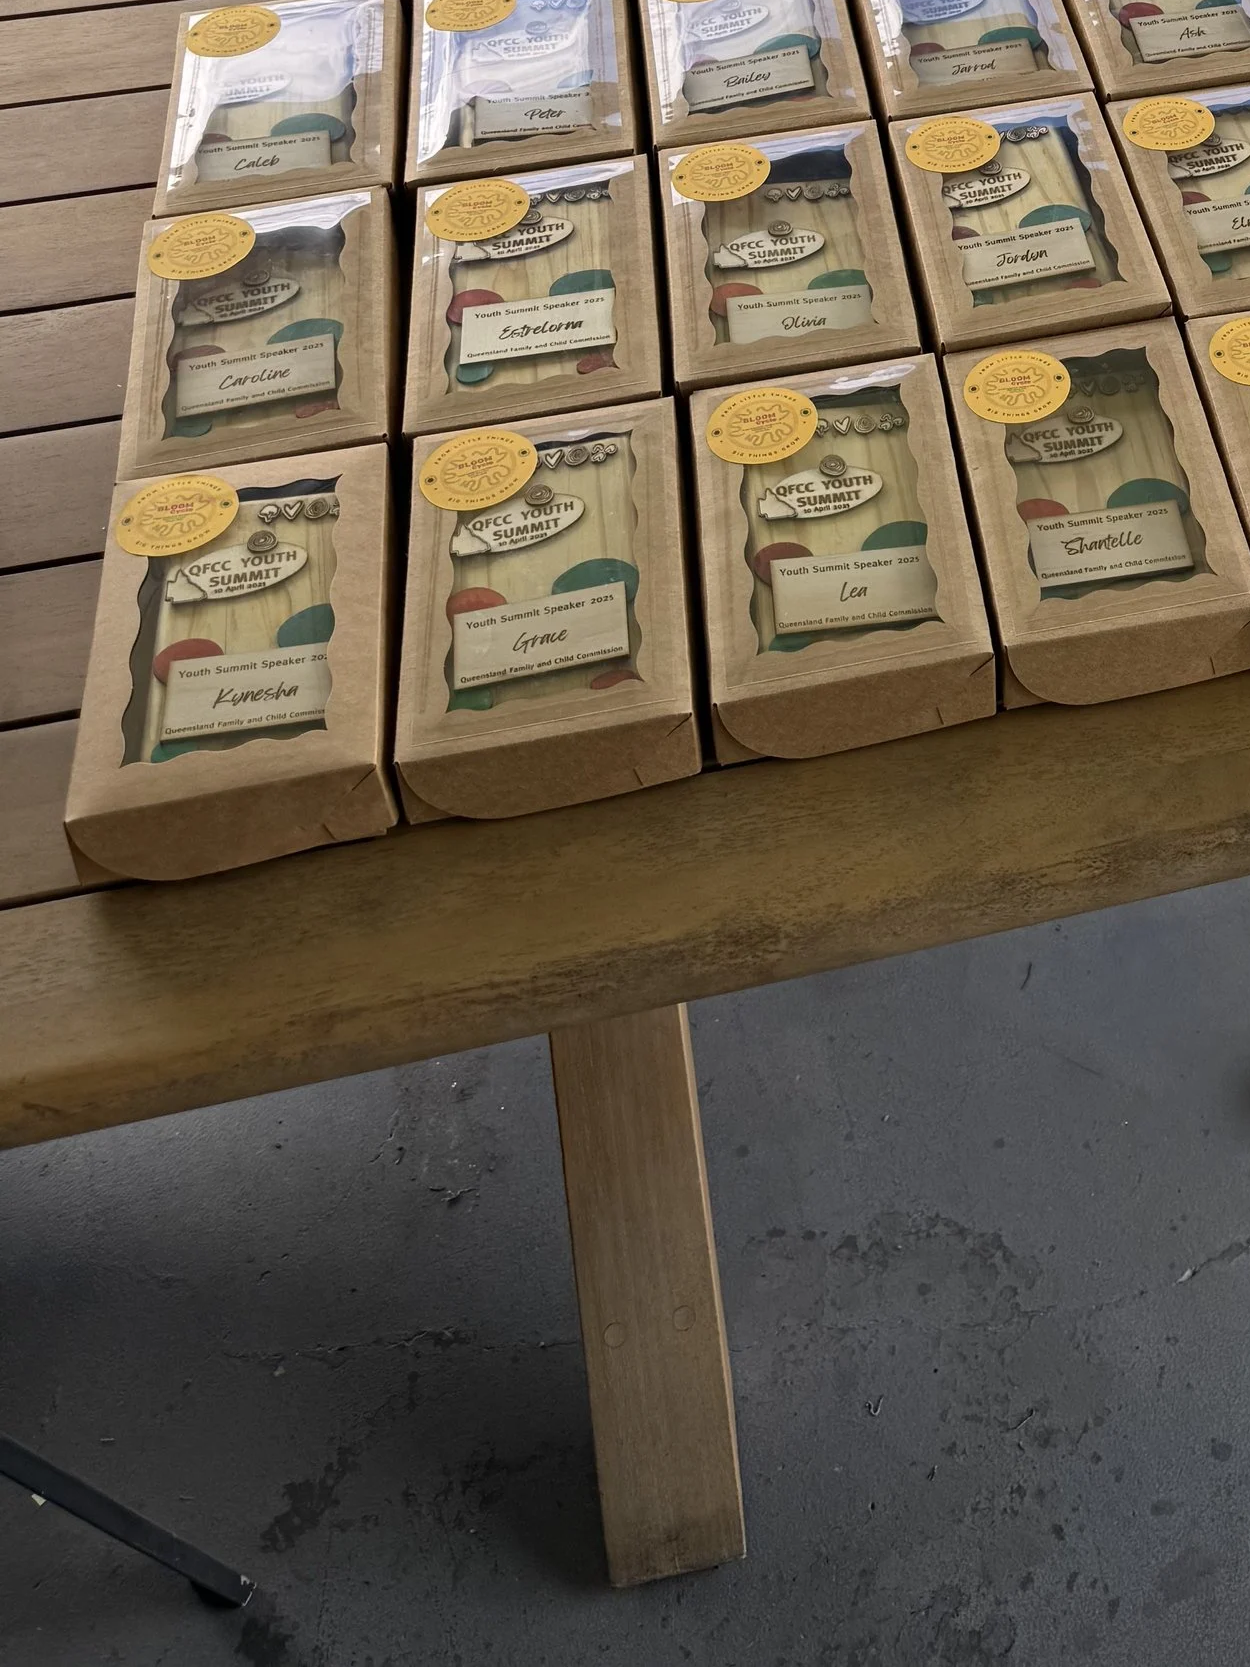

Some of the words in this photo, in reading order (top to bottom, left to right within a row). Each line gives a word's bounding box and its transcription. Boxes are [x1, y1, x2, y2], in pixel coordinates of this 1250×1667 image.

[722, 8, 762, 19] YOUTH
[922, 3, 970, 15] SUMMIT
[701, 18, 752, 33] SUMMIT
[1179, 27, 1206, 40] Ash
[487, 38, 519, 47] QFCC
[504, 44, 557, 54] SUMMIT
[748, 54, 779, 65] Speaker
[951, 60, 996, 76] Jarrod
[724, 72, 771, 88] Bailey
[524, 107, 567, 120] Peter
[226, 142, 259, 152] Summit
[262, 139, 297, 149] Speaker
[1203, 143, 1245, 156] YOUTH
[234, 155, 280, 171] Caleb
[1187, 154, 1238, 170] SUMMIT
[979, 172, 1022, 186] YOUTH
[959, 184, 1013, 200] SUMMIT
[1187, 206, 1210, 216] Youth
[1212, 201, 1242, 212] Summit
[518, 222, 565, 236] YOUTH
[492, 235, 553, 251] SUMMIT
[730, 240, 764, 252] QFCC
[770, 234, 816, 246] YOUTH
[958, 242, 982, 251] Youth
[985, 236, 1017, 247] Summit
[1019, 229, 1052, 241] Speaker
[748, 246, 806, 260] SUMMIT
[197, 293, 234, 307] QFCC
[241, 283, 291, 297] YOUTH
[737, 302, 763, 311] Youth
[767, 298, 800, 308] Summit
[803, 295, 837, 304] Speaker
[215, 295, 278, 314] SUMMIT
[475, 310, 501, 319] Youth
[505, 305, 539, 316] Summit
[543, 300, 579, 311] Speaker
[782, 315, 827, 331] Olivia
[189, 360, 217, 372] Youth
[221, 354, 256, 366] Summit
[260, 346, 300, 360] Speaker
[303, 342, 324, 351] 2025
[219, 367, 291, 391] Caroline
[742, 413, 777, 424] BLOOM
[1065, 422, 1115, 436] YOUTH
[1043, 436, 1105, 453] SUMMIT
[457, 455, 494, 470] BLOOM
[775, 483, 815, 498] QFCC
[821, 475, 874, 490] YOUTH
[796, 490, 862, 508] SUMMIT
[472, 514, 513, 532] QFCC
[520, 500, 575, 520] YOUTH
[813, 504, 831, 513] April
[1036, 521, 1065, 532] Youth
[1067, 516, 1104, 528] Summit
[1106, 511, 1144, 524] Speaker
[1146, 508, 1169, 517] 2025
[492, 517, 561, 542] SUMMIT
[508, 536, 528, 547] April
[1060, 531, 1144, 557] Shantelle
[188, 560, 232, 577] QFCC
[241, 550, 298, 569] YOUTH
[779, 566, 809, 577] Youth
[812, 562, 851, 574] Summit
[853, 559, 893, 571] Speaker
[897, 556, 920, 564] 2025
[209, 567, 282, 588] SUMMIT
[225, 584, 245, 593] April
[839, 581, 868, 602] Lea
[466, 617, 497, 630] Youth
[500, 608, 540, 624] Summit
[543, 600, 586, 615] Speaker
[590, 594, 614, 605] 2025
[778, 618, 823, 629] Queensland
[825, 614, 850, 624] Family
[851, 613, 866, 621] and
[868, 610, 887, 620] Child
[888, 607, 933, 617] Commission
[512, 629, 568, 654] Grace
[178, 667, 211, 679] Youth
[215, 661, 258, 674] Summit
[261, 655, 306, 671] Speaker
[460, 669, 507, 684] Queensland
[509, 663, 535, 675] Family
[537, 660, 552, 669] and
[554, 655, 575, 665] Child
[576, 645, 624, 661] Commission
[212, 681, 299, 709] Kynesha
[165, 722, 215, 735] Queensland
[217, 717, 244, 729] Family
[247, 716, 263, 725] and
[265, 713, 286, 722] Child
